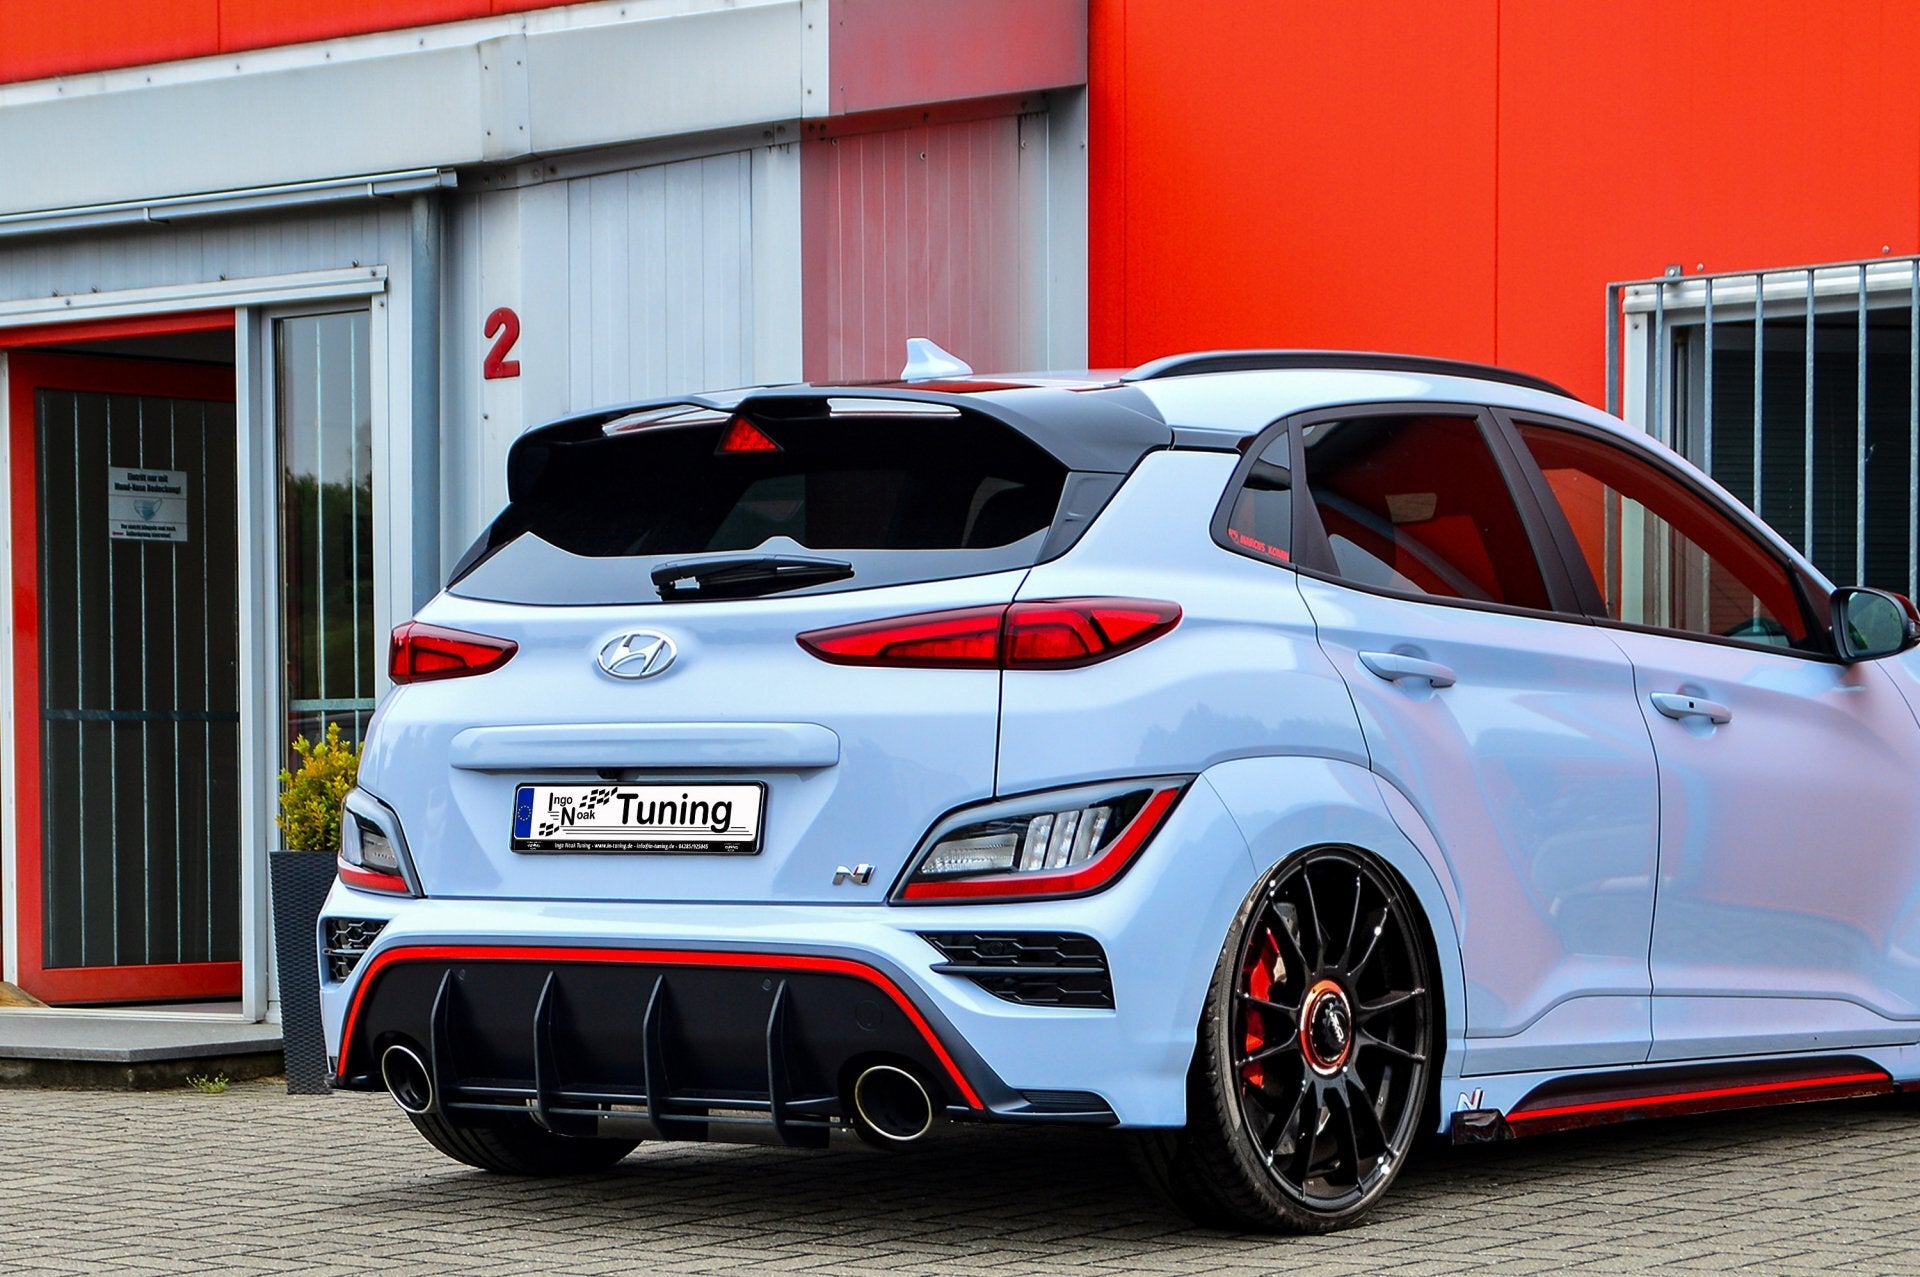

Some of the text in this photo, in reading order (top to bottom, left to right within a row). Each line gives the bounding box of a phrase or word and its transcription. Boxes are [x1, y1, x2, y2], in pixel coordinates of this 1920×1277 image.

[484, 307, 520, 379] 2
[549, 792, 573, 812] Ingo
[561, 807, 596, 826] Noak
[616, 792, 732, 834] Tuning
